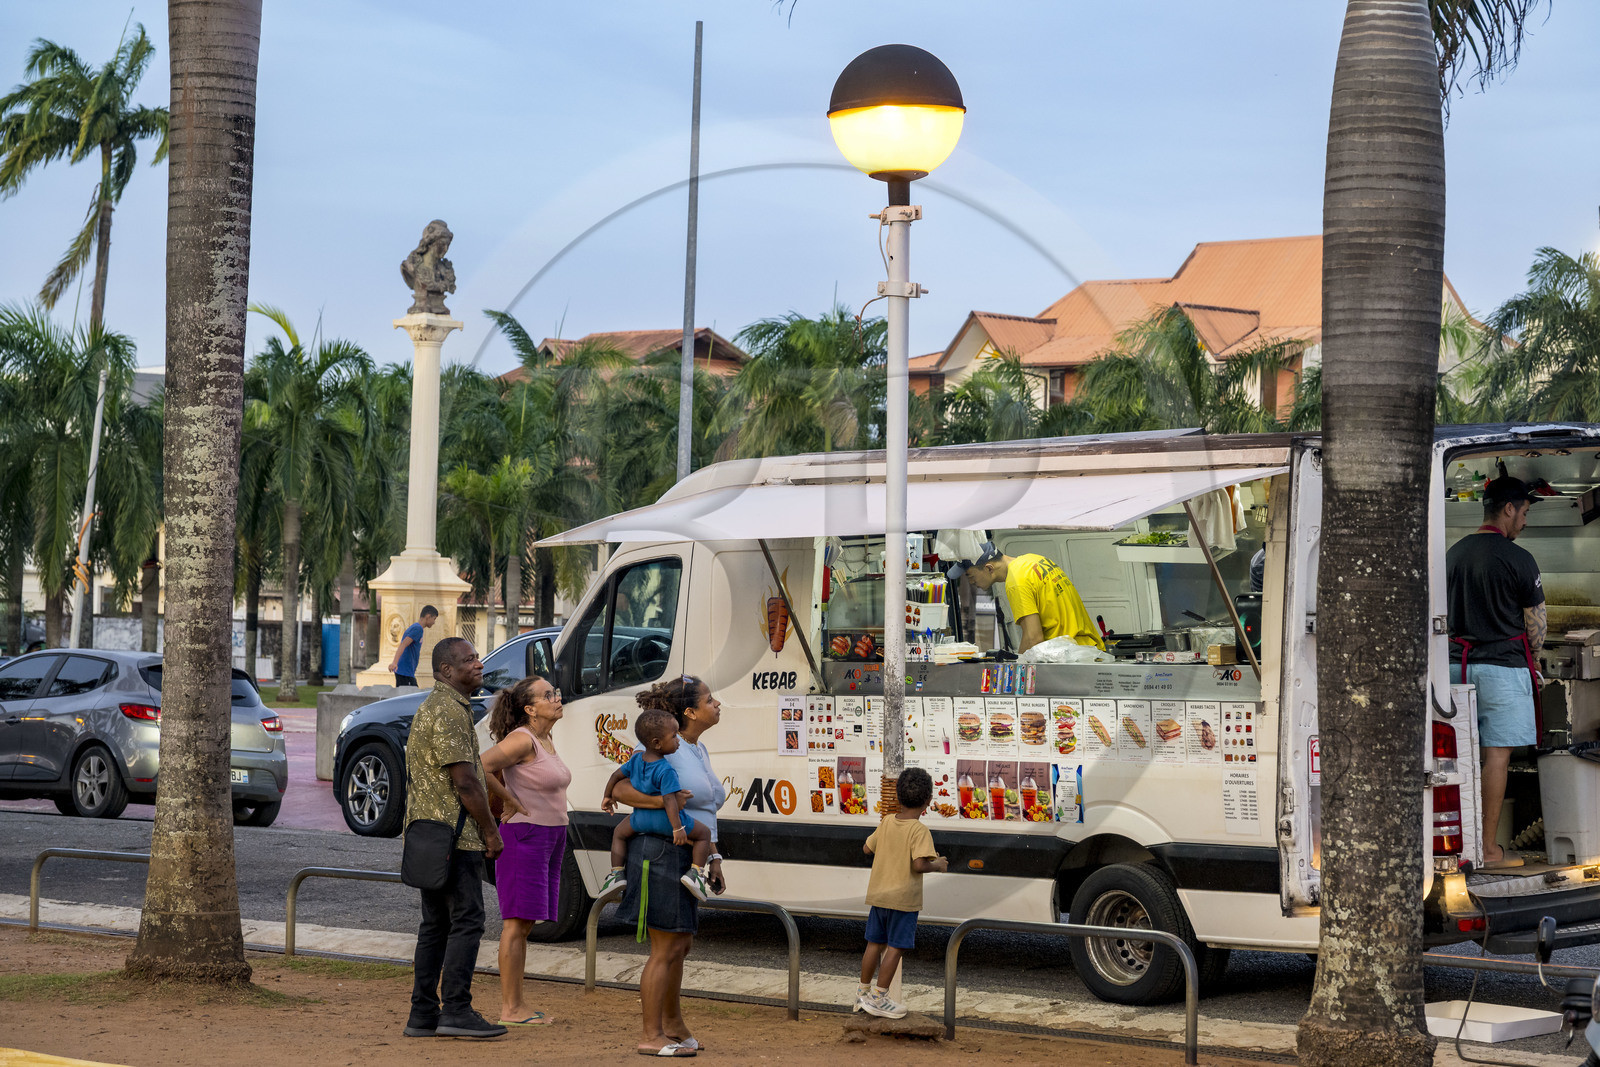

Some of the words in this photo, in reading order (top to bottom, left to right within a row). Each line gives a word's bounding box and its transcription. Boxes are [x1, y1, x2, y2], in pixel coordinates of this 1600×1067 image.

[752, 671, 797, 690] KEBAB
[1220, 669, 1242, 682] AK9
[595, 713, 628, 737] Kebab
[723, 775, 745, 808] Chez
[740, 777, 797, 816] AK9
